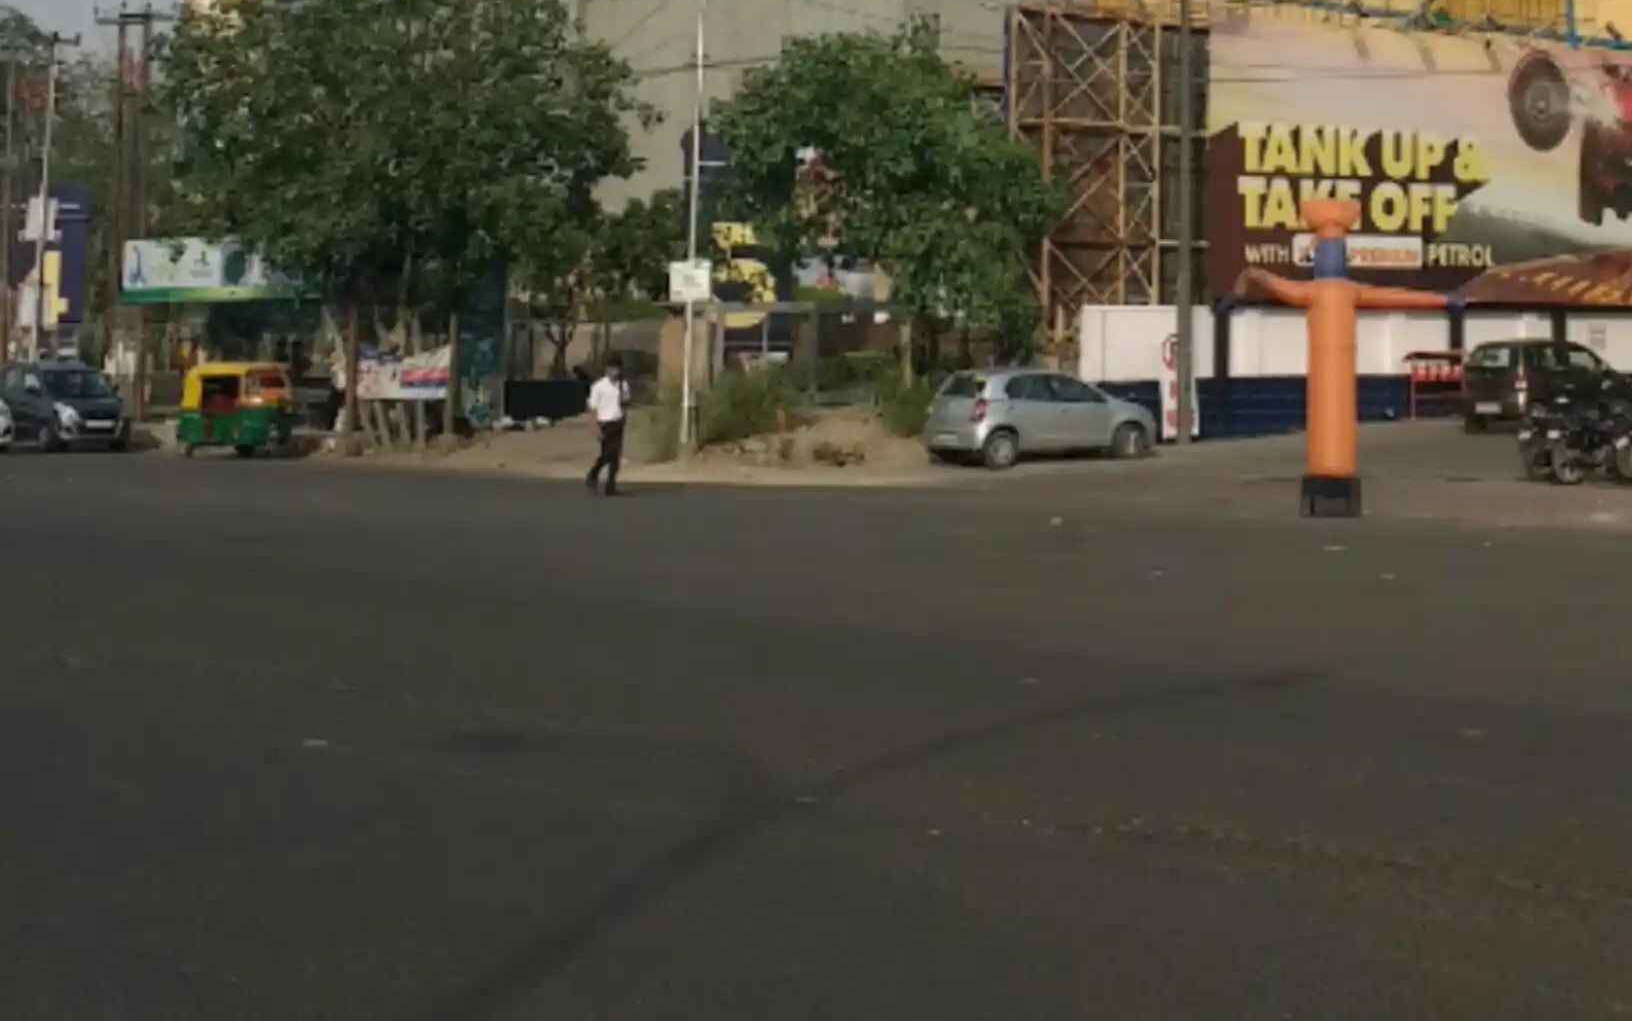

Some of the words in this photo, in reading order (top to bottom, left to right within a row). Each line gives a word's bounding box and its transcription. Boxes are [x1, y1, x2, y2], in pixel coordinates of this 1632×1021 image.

[1237, 123, 1372, 178] TANK
[1381, 128, 1447, 180] UP
[1452, 137, 1492, 182] &
[1370, 181, 1459, 232] OFF
[1427, 242, 1496, 267] PETROL
